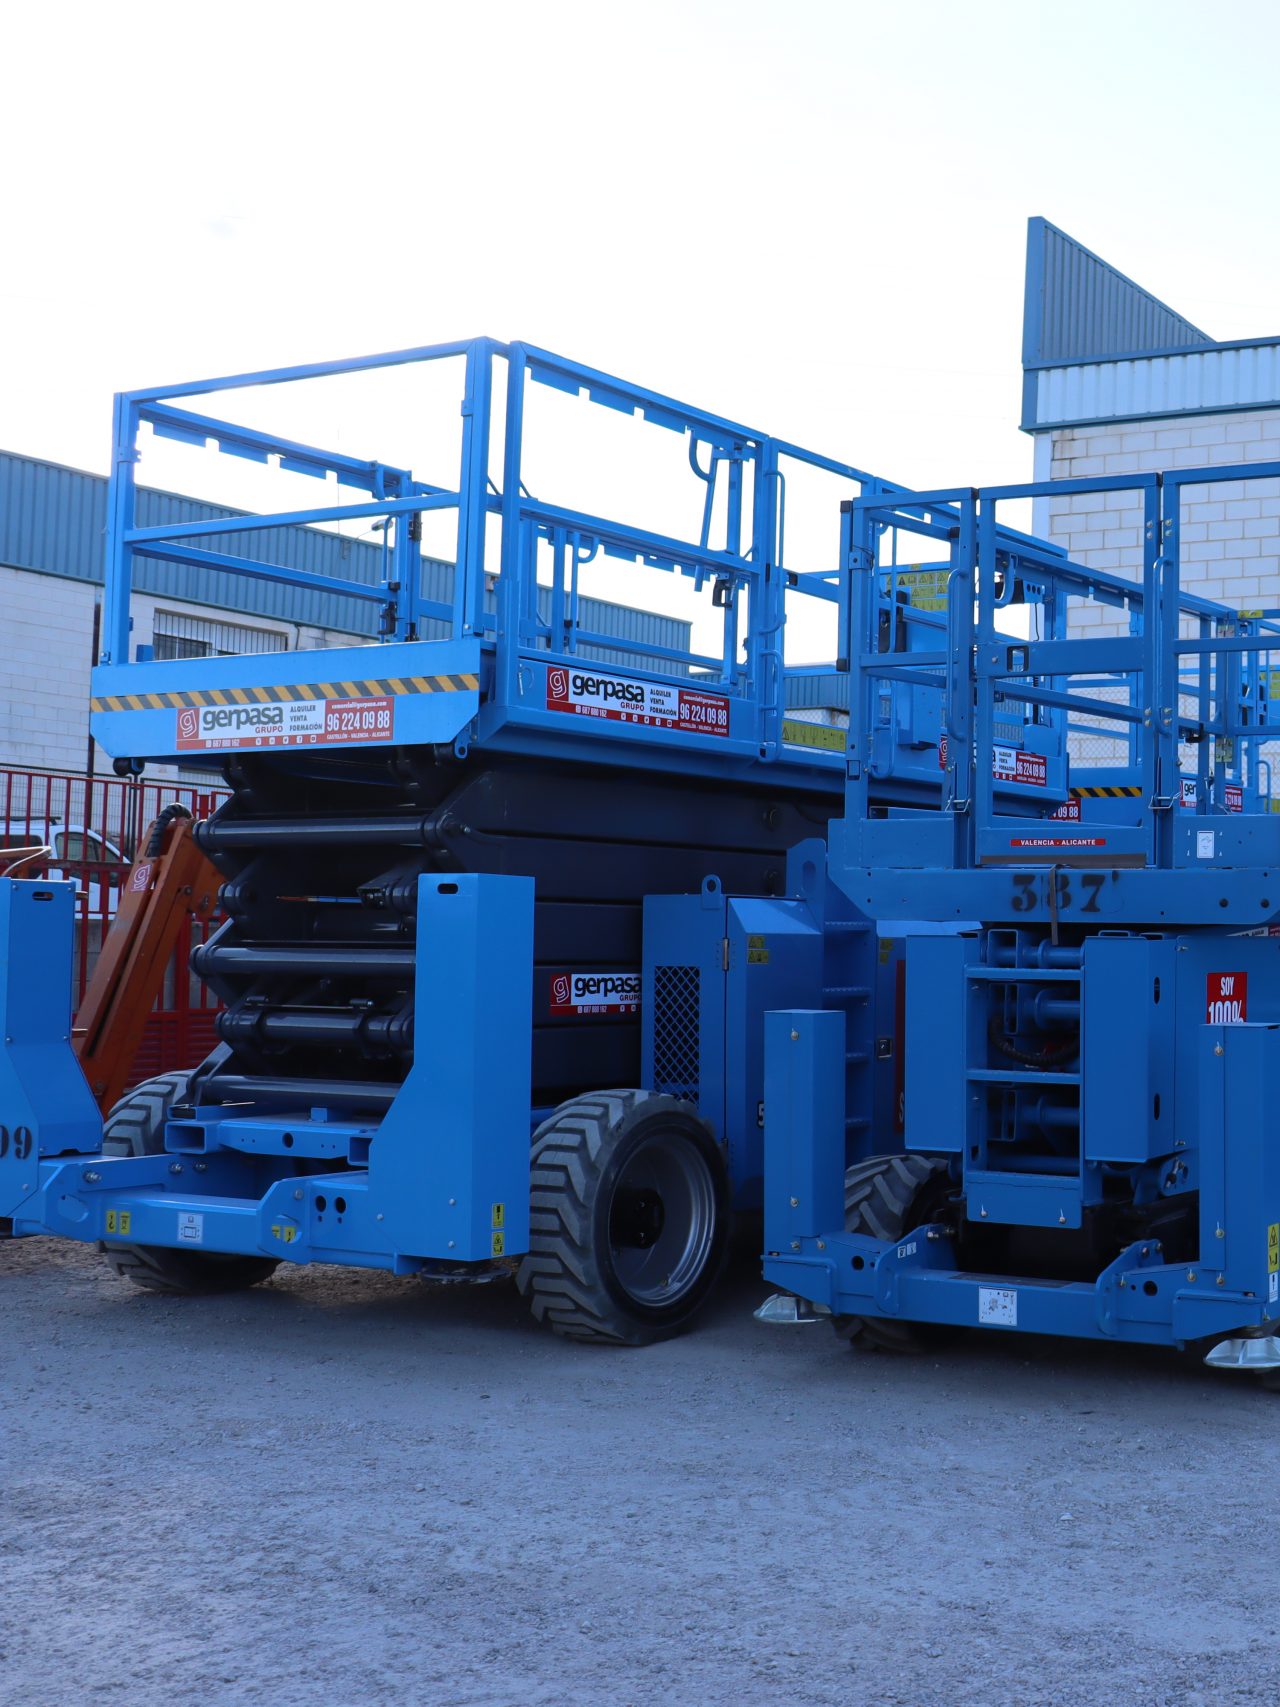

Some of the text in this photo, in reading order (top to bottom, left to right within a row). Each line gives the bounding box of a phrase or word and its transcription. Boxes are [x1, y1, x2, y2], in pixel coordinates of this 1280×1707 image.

[572, 674, 645, 703] gerpasa
[290, 705, 317, 713] ALQUILER
[620, 701, 645, 712] GRUPO
[679, 703, 727, 726] 96 224 09 88
[202, 706, 284, 731] gerpasa
[290, 714, 308, 722] VENTA
[327, 710, 390, 731] 96 224 09 88
[255, 725, 284, 734] GRUPO
[289, 723, 323, 732] FORMACIÓN
[1058, 806, 1078, 818] 09 88
[1011, 873, 1106, 913] 387
[1220, 976, 1235, 997] SOY
